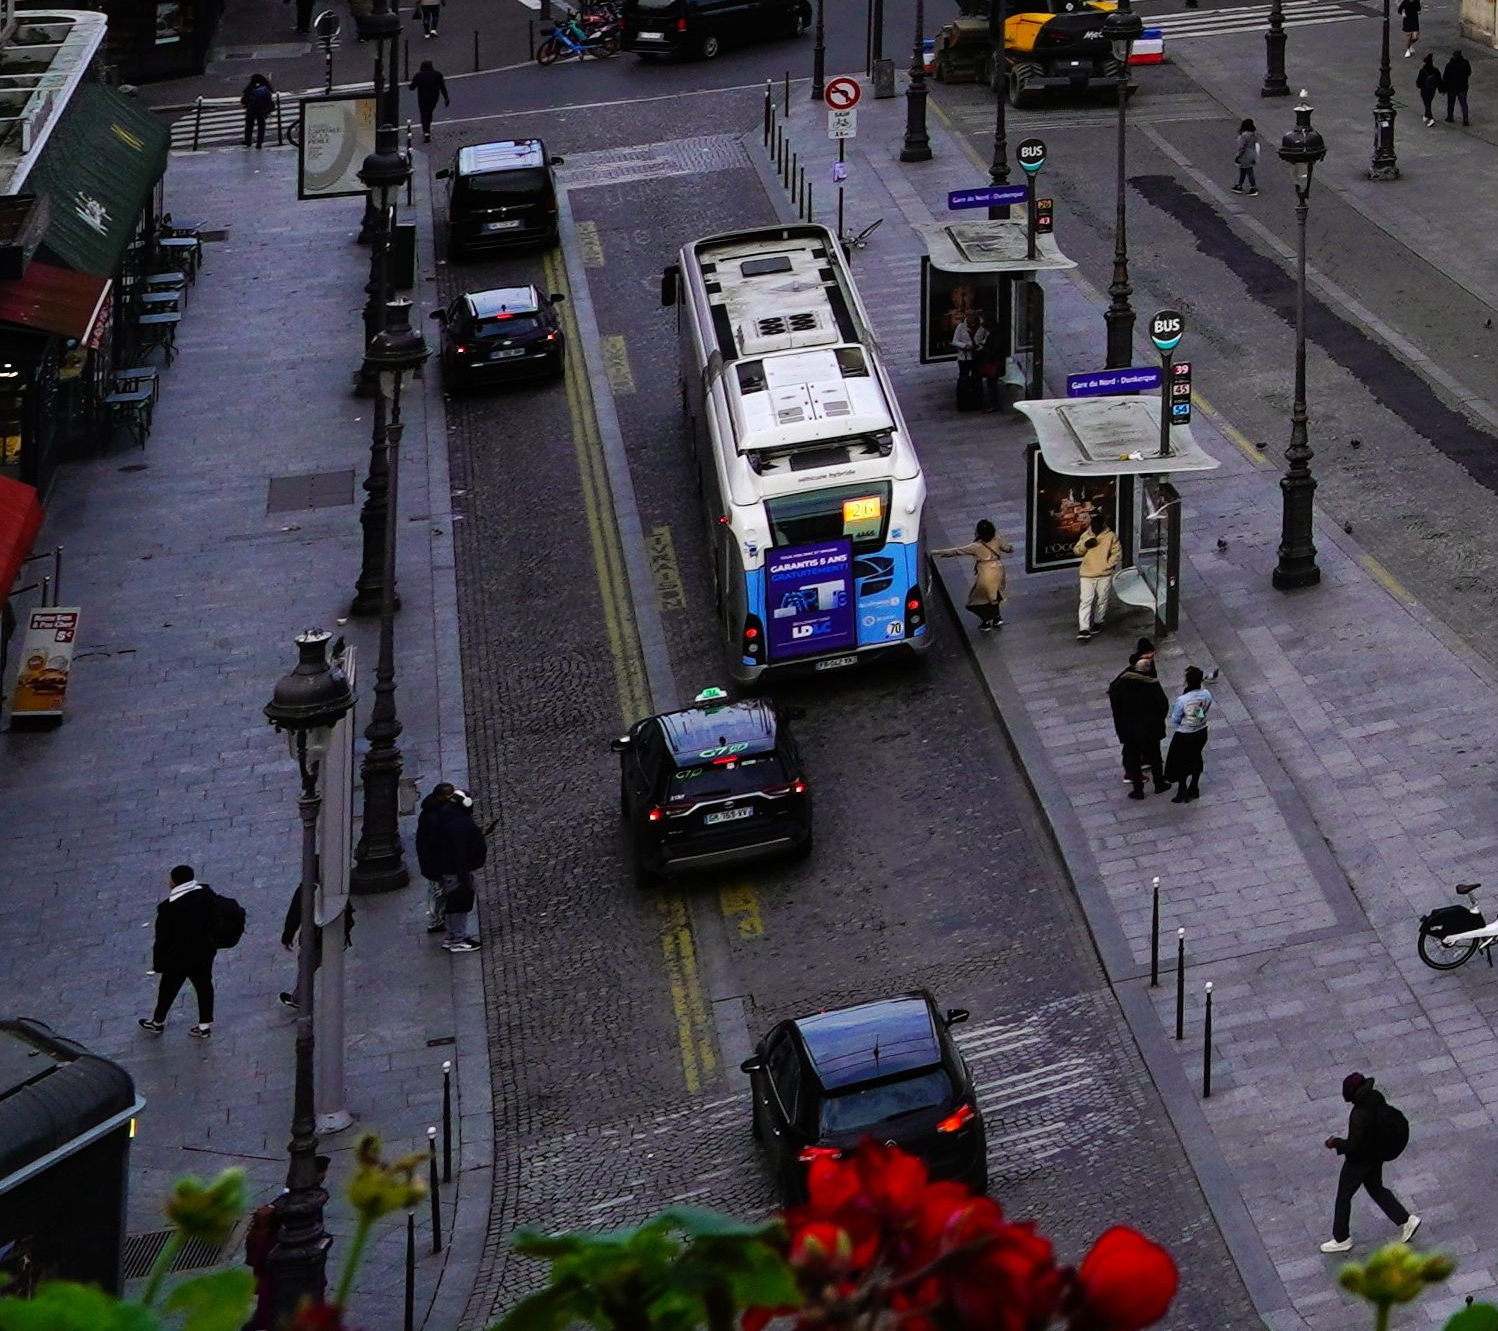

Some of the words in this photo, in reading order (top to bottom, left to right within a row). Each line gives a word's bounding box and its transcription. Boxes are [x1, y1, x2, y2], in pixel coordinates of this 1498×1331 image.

[1021, 145, 1043, 157] BUS
[952, 195, 965, 204] Gare
[976, 194, 990, 202] Nord
[1154, 318, 1181, 334] BUS
[1175, 364, 1188, 374] 39
[1072, 380, 1087, 390] Gare
[1089, 379, 1097, 388] du
[1099, 377, 1115, 387] Nord
[1121, 373, 1157, 385] Dunkerque
[852, 500, 874, 518] 26
[770, 559, 818, 574] GARANTIS
[827, 554, 848, 564] ANS
[792, 621, 831, 639] LDLC
[890, 622, 902, 635] 70
